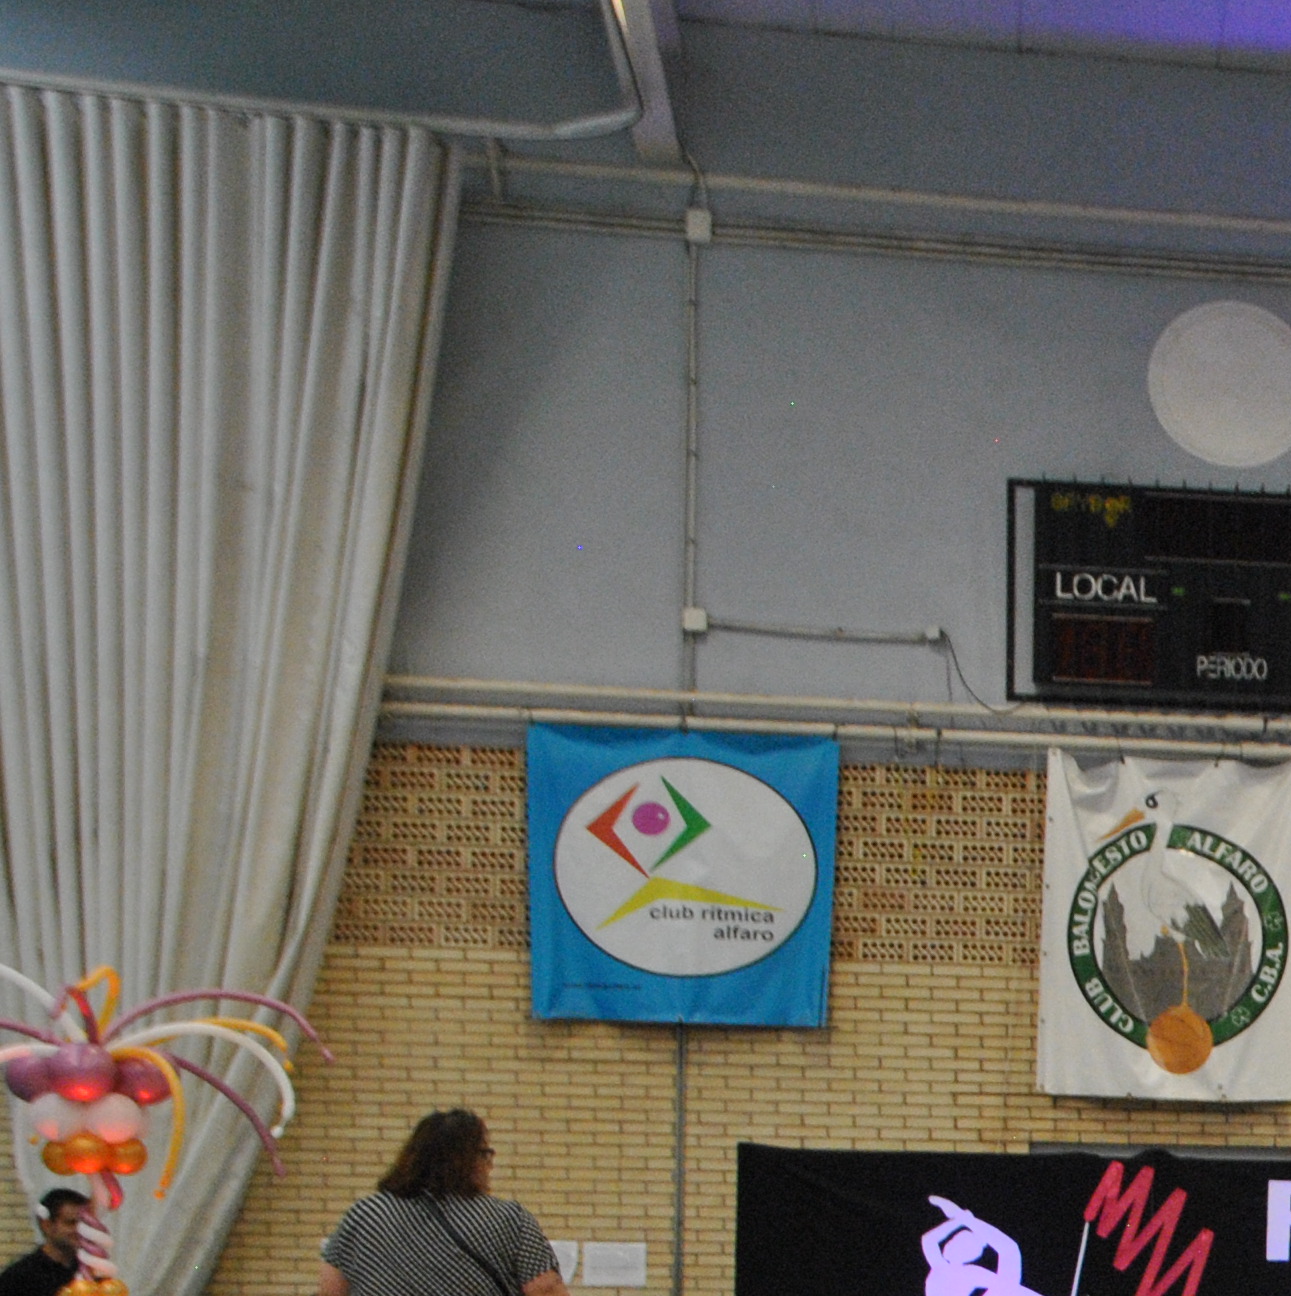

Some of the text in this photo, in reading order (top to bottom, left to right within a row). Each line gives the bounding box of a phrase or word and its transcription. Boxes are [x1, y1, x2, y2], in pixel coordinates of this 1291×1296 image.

[1055, 572, 1157, 604] LOCAL
[1196, 655, 1268, 681] PERIODO
[1186, 833, 1269, 894] ALFARO
[650, 904, 694, 921] club
[713, 926, 775, 942] alfaro
[1085, 977, 1134, 1033] CLUB
